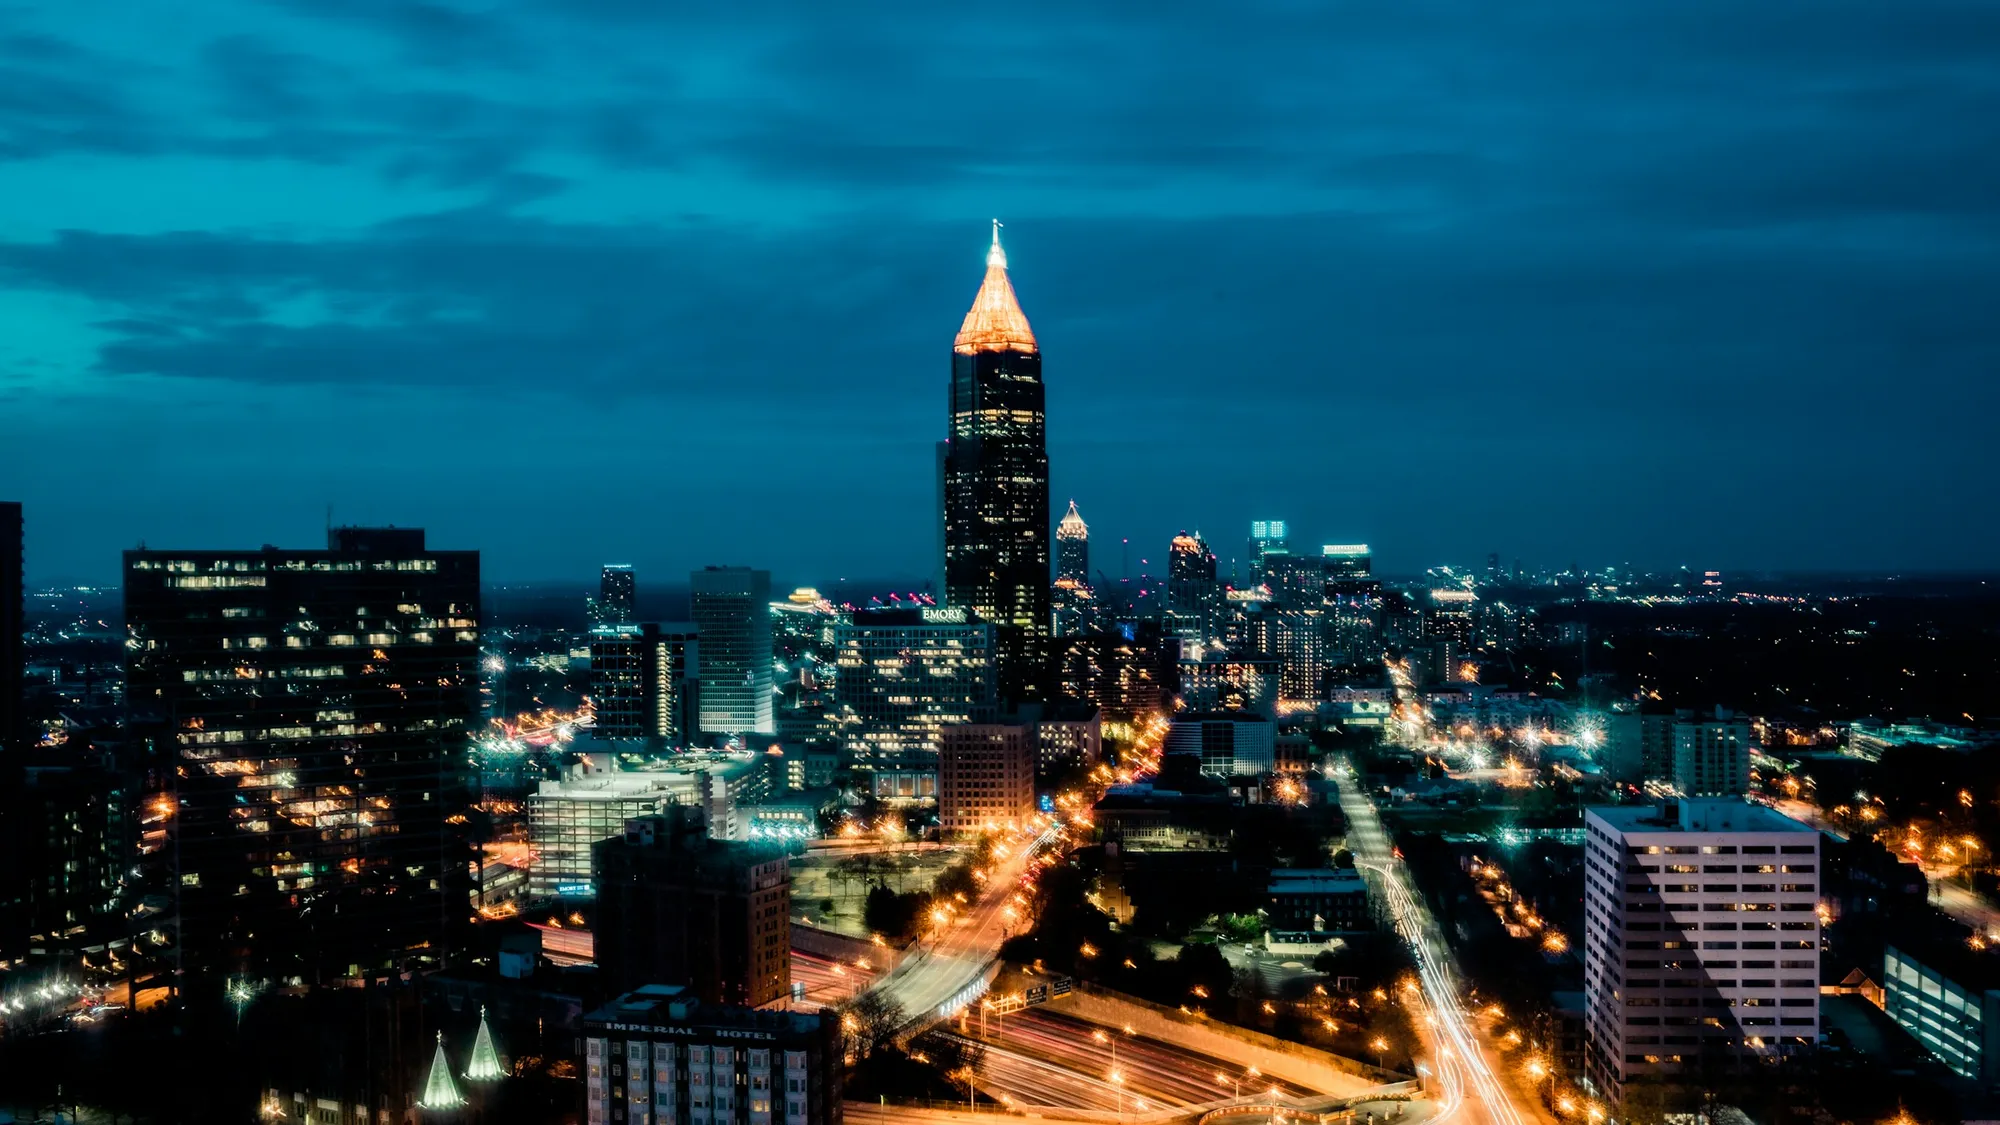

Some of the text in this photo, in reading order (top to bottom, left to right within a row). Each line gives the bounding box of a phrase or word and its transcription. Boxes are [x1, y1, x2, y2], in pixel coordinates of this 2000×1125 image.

[923, 609, 962, 619] EMORY
[606, 1022, 777, 1040] IMPERIAL HOTEL
